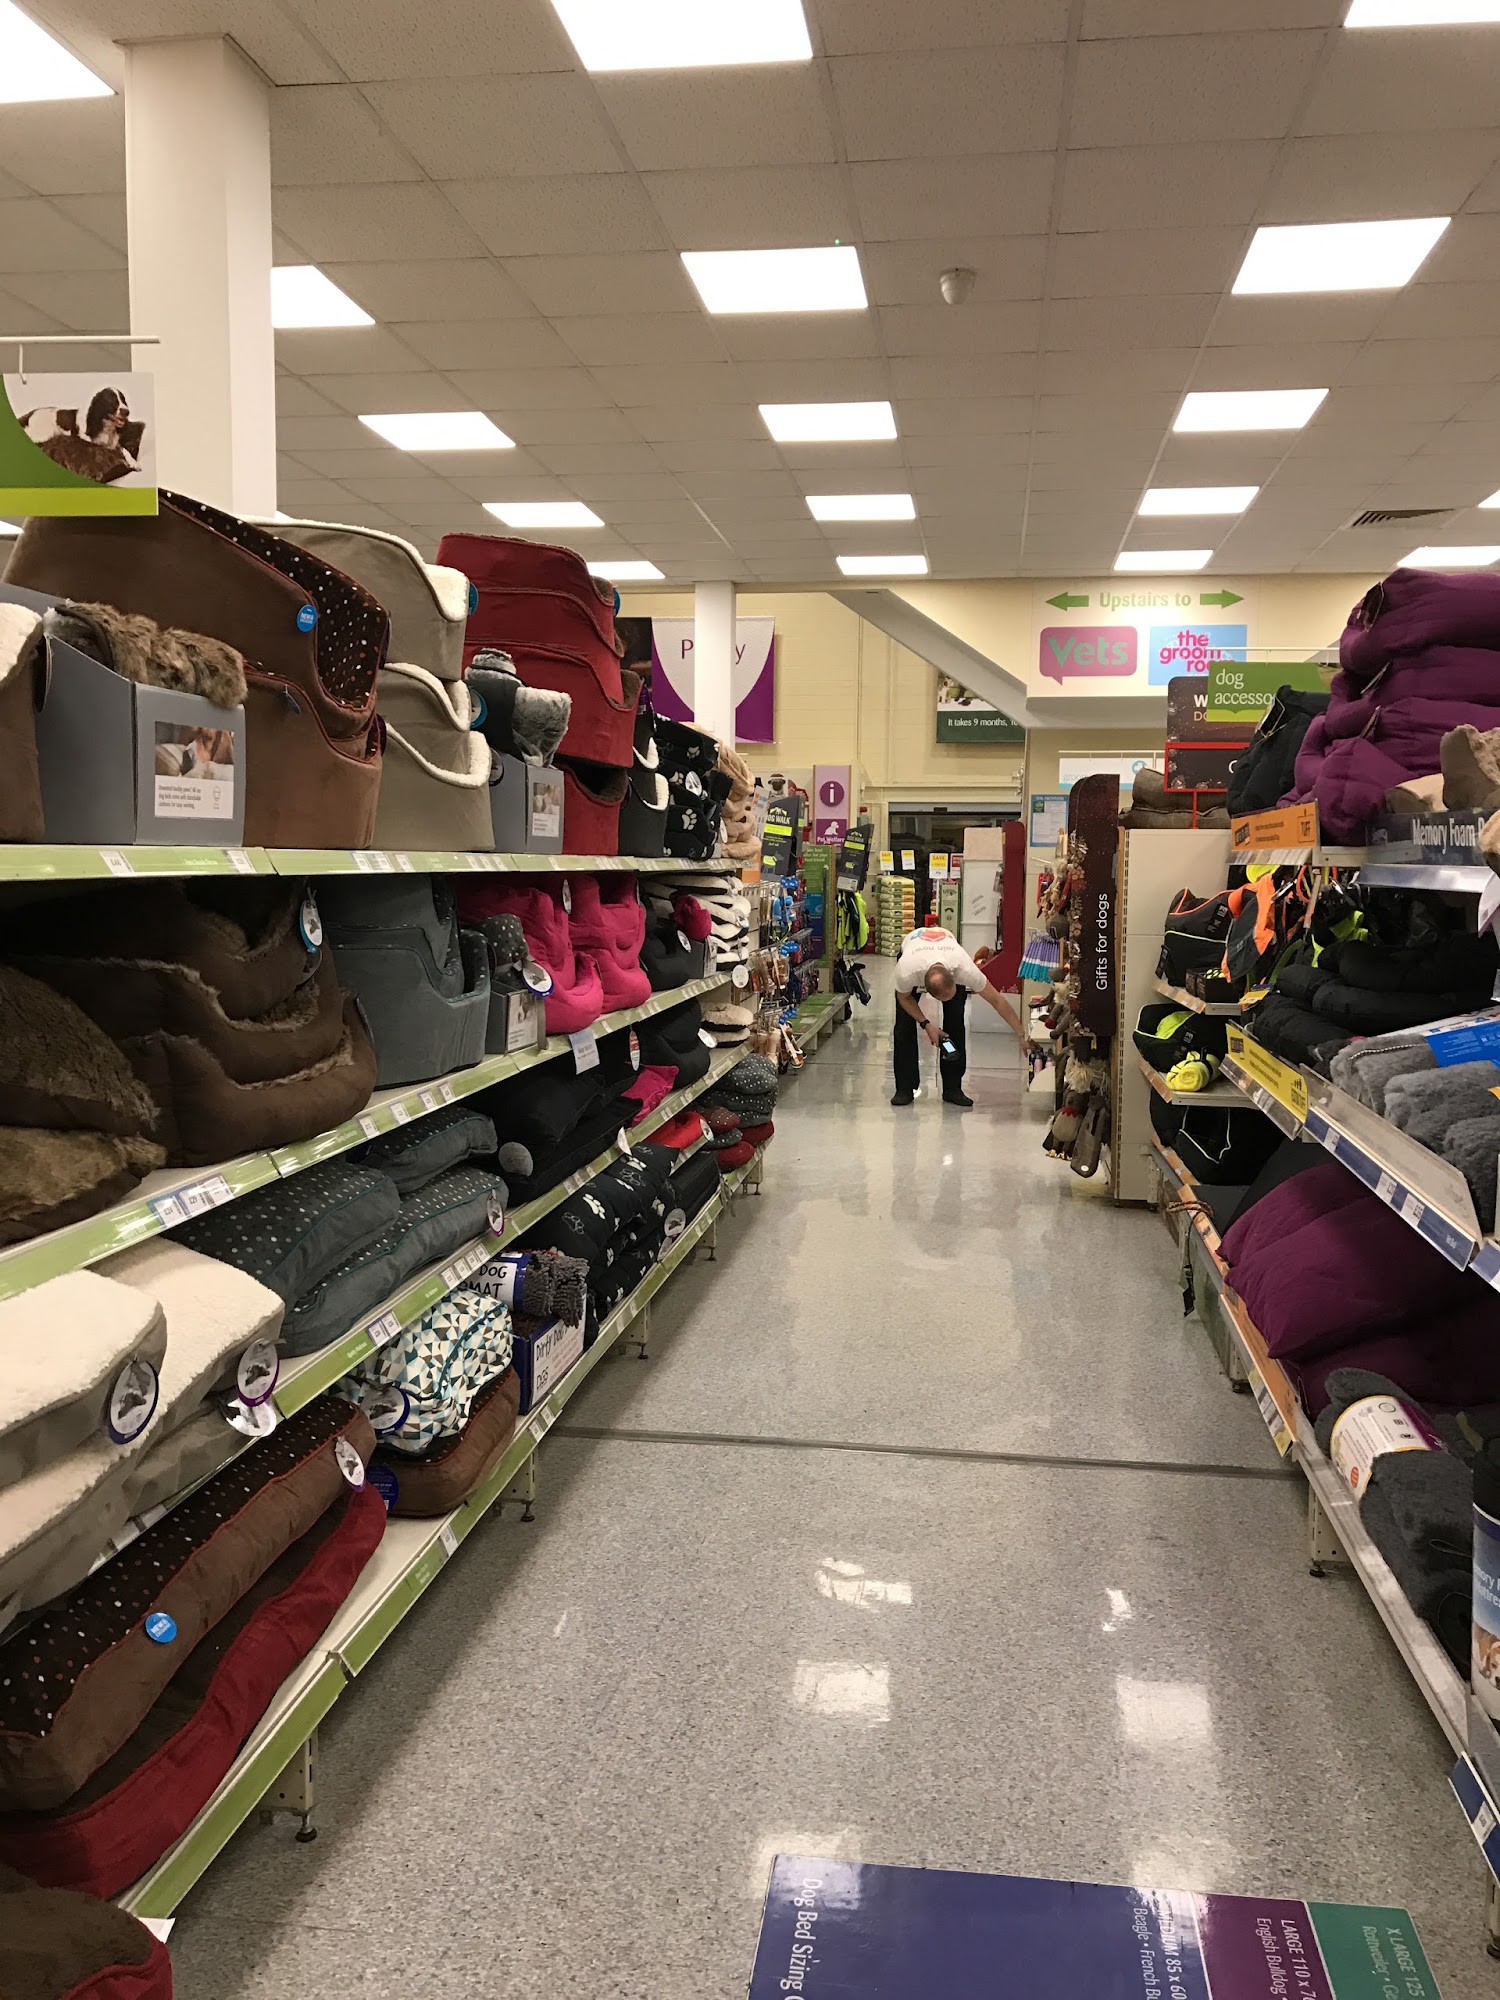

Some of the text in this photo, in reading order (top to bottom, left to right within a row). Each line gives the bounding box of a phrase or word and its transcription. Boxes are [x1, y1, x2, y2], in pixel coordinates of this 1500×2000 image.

[1100, 592, 1191, 611] Upstairs to
[1047, 636, 1128, 668] Vets
[1177, 630, 1209, 647] the
[1160, 647, 1221, 664] groom
[1216, 668, 1244, 690] dog
[1214, 692, 1272, 705] accesso
[948, 718, 954, 726] It
[954, 718, 972, 726] takes
[974, 718, 978, 726] 9
[980, 718, 1008, 726] months,
[777, 816, 791, 825] WALK
[1412, 818, 1448, 854] Memory
[1449, 817, 1476, 847] Foam
[1095, 893, 1110, 990] Gifts for dogs
[479, 1264, 508, 1279] DOG
[794, 1877, 823, 1907] Dog
[794, 1910, 818, 1940] Bed
[1132, 1906, 1149, 1941] Beagle
[1157, 1908, 1178, 1958] MEDIUM
[1255, 1918, 1288, 1995] English Bulldog
[1280, 1919, 1304, 1954] LARGE
[1292, 1956, 1310, 1979] 110
[1362, 1925, 1391, 1975] Rottweiler
[1385, 1926, 1425, 1998] X LARGE 125
[780, 1943, 814, 1991] Sizing
[1140, 1950, 1160, 1984] French
[1165, 1958, 1182, 1974] 85
